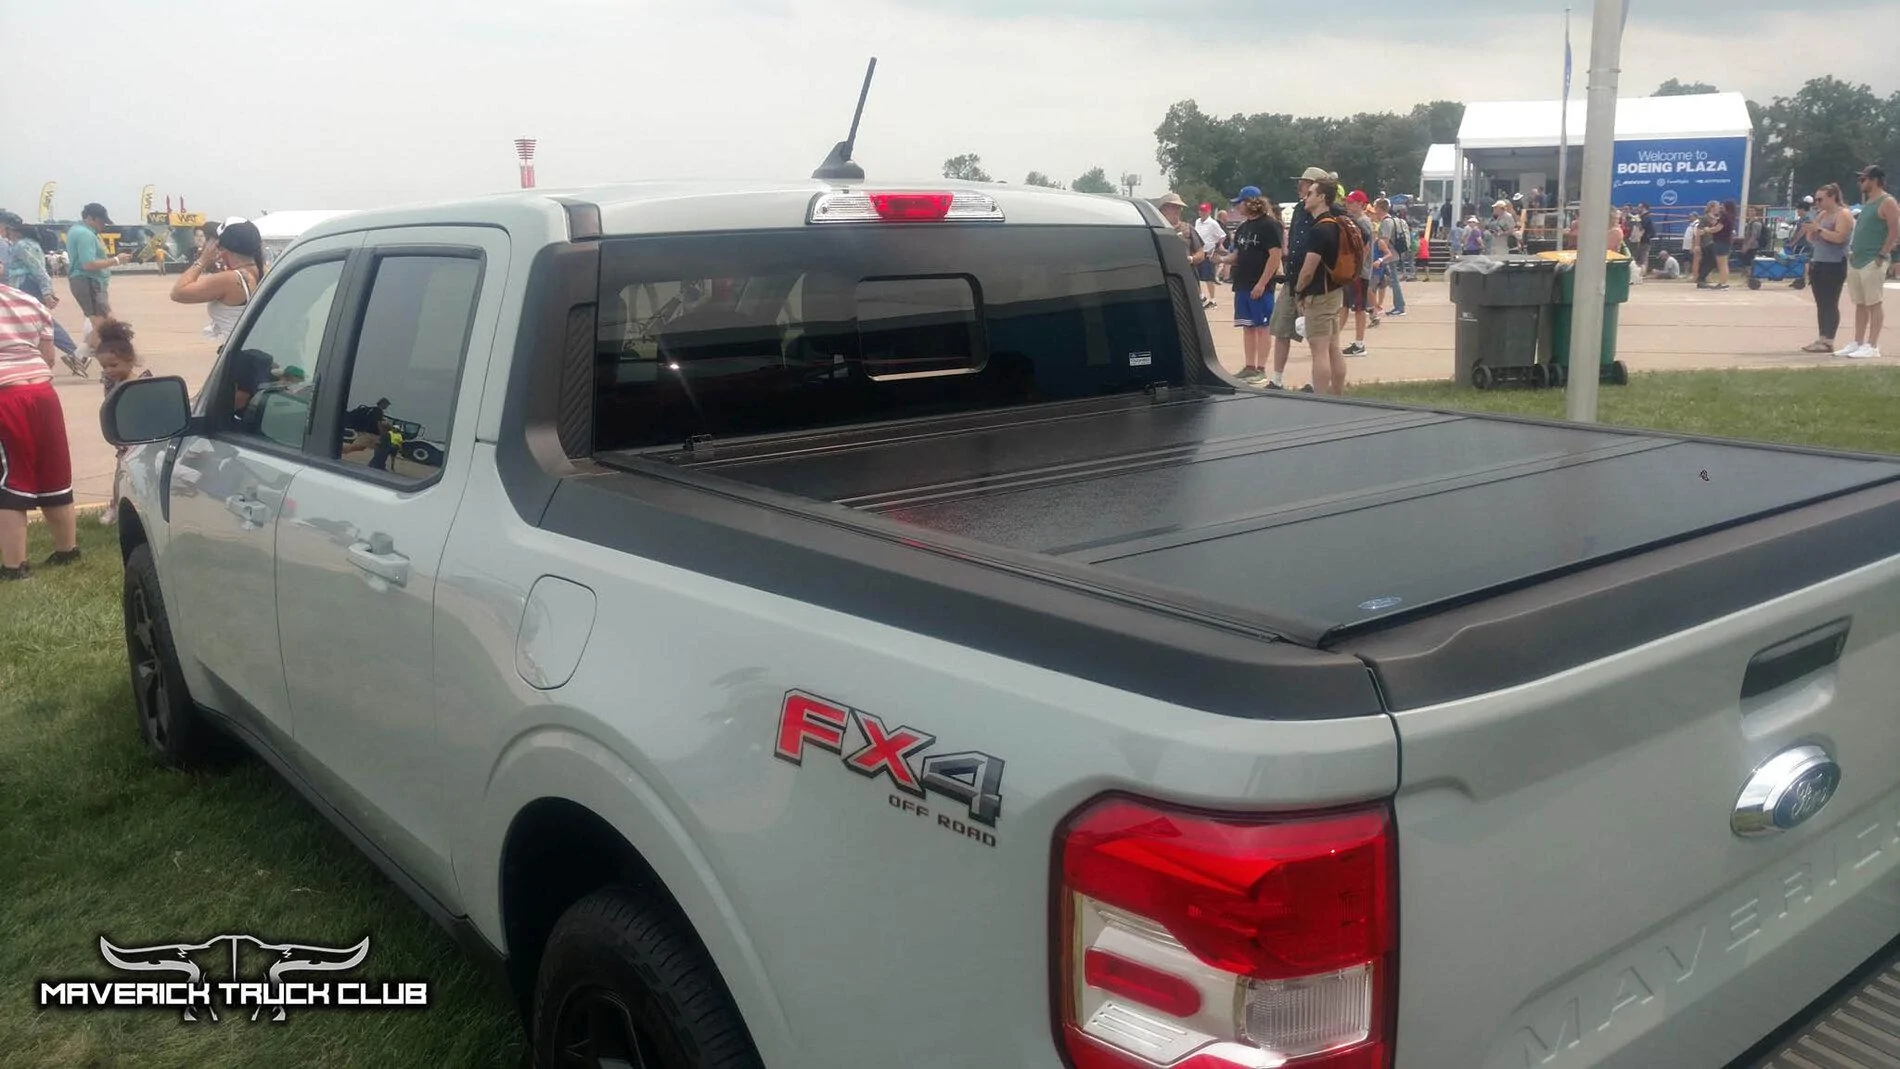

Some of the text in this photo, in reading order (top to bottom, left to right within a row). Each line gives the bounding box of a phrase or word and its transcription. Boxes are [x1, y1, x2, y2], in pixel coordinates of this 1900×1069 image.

[1617, 160, 1728, 174] BOEING PLAZA
[1638, 150, 1708, 162] Welcome to
[774, 687, 1006, 828] FX4
[889, 794, 996, 848] OFF ROAD
[1513, 800, 1900, 1069] MAVERIC
